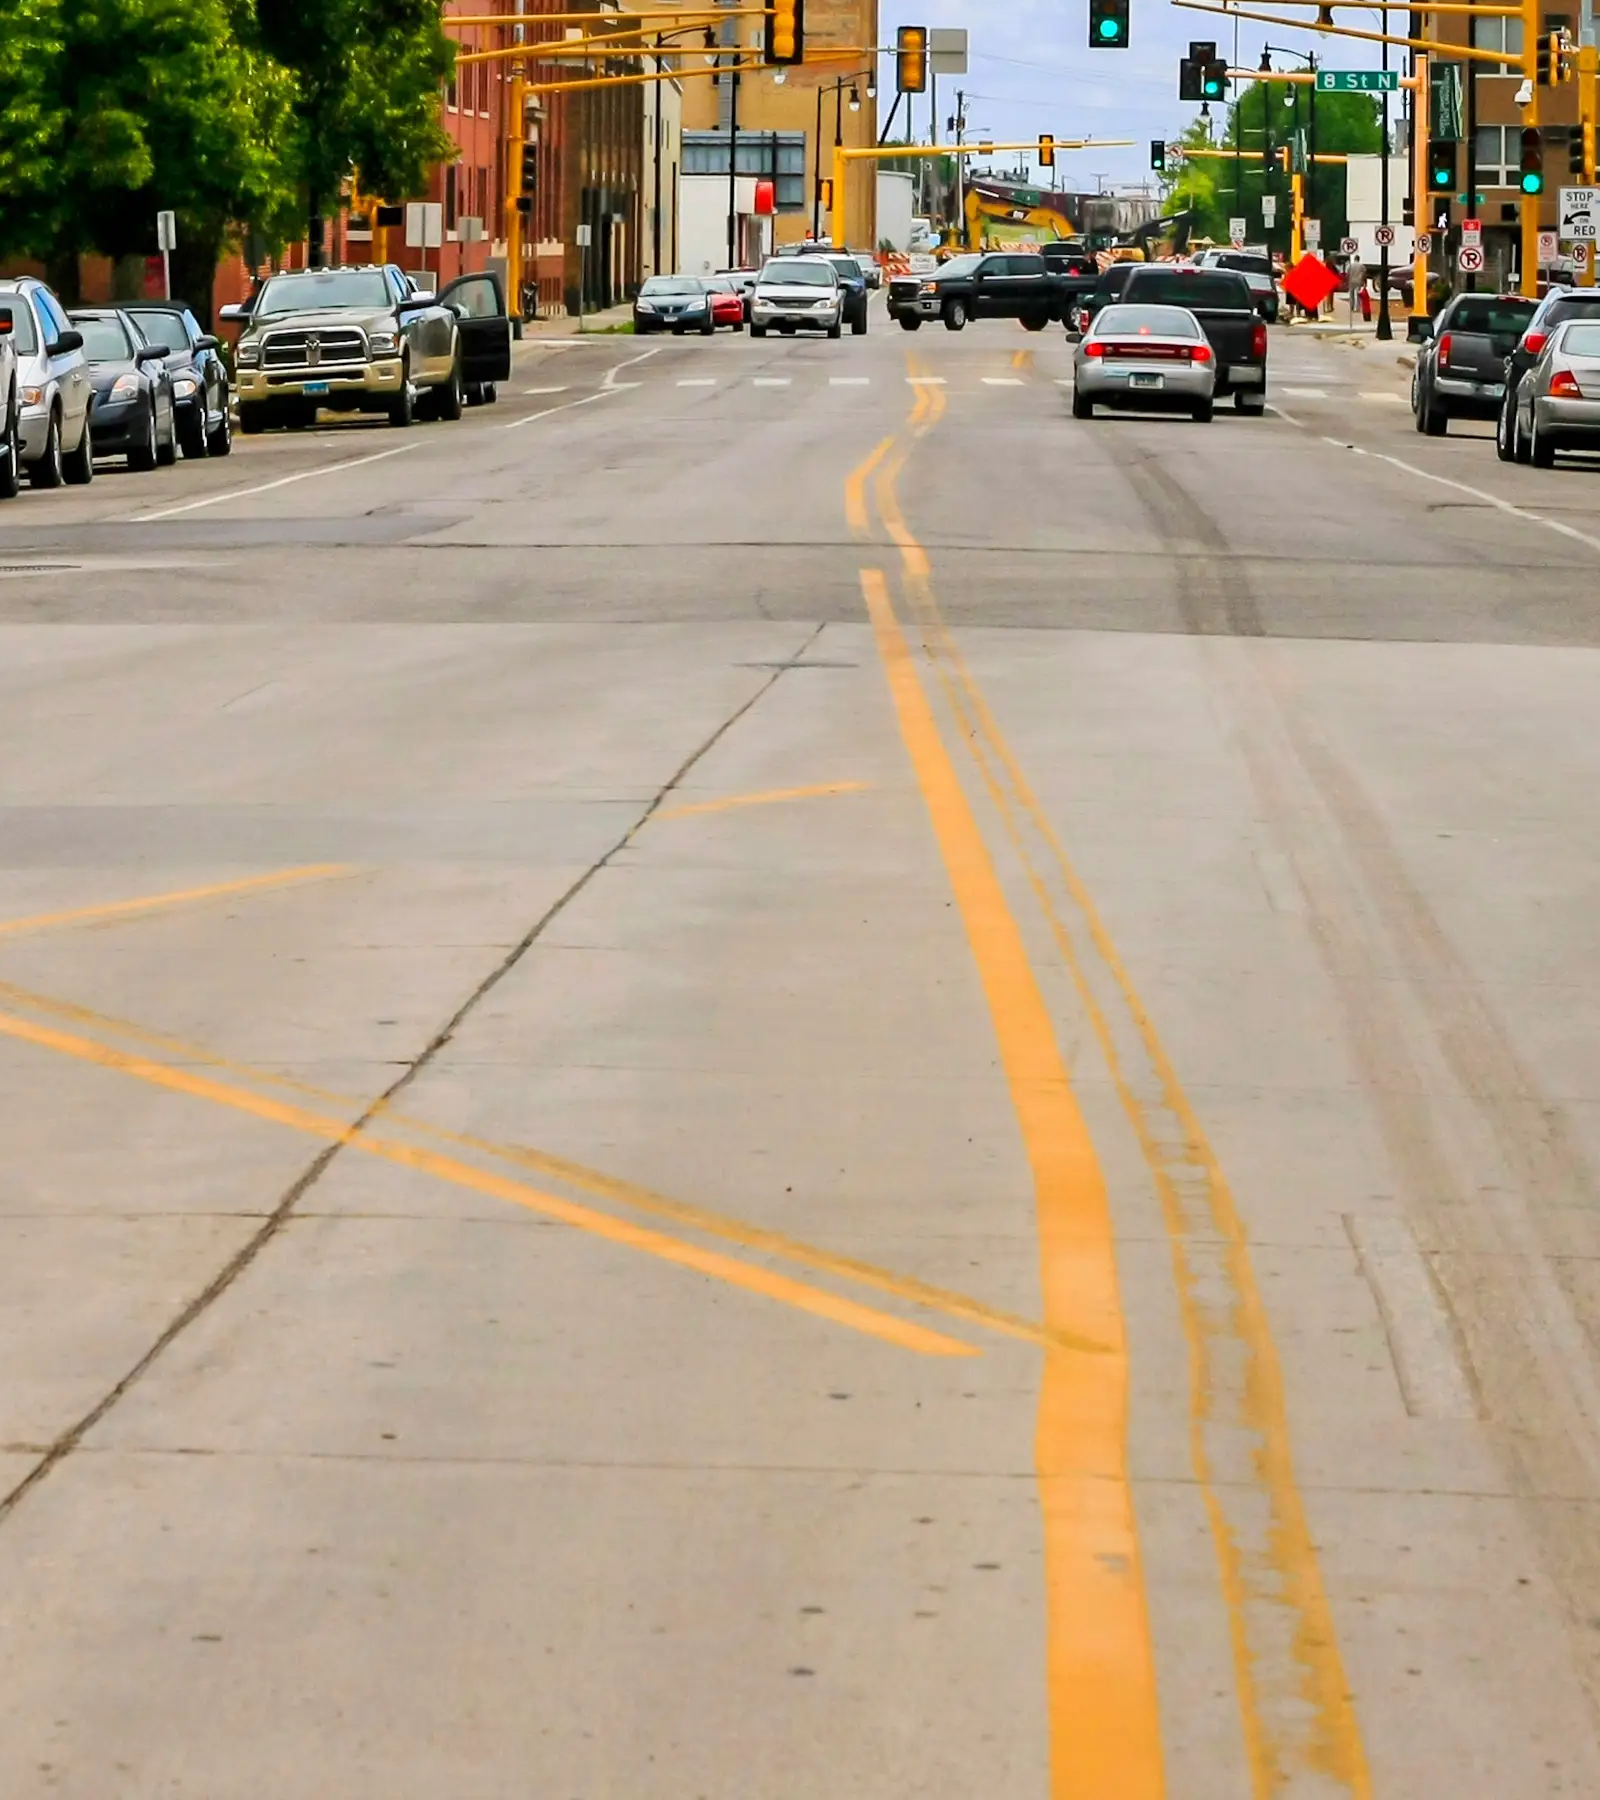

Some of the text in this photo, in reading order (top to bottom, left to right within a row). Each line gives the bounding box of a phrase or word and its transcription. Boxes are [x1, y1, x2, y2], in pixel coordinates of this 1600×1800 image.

[1324, 74, 1391, 88] 8 St N
[1566, 192, 1594, 201] STOP
[1574, 225, 1596, 235] RED
